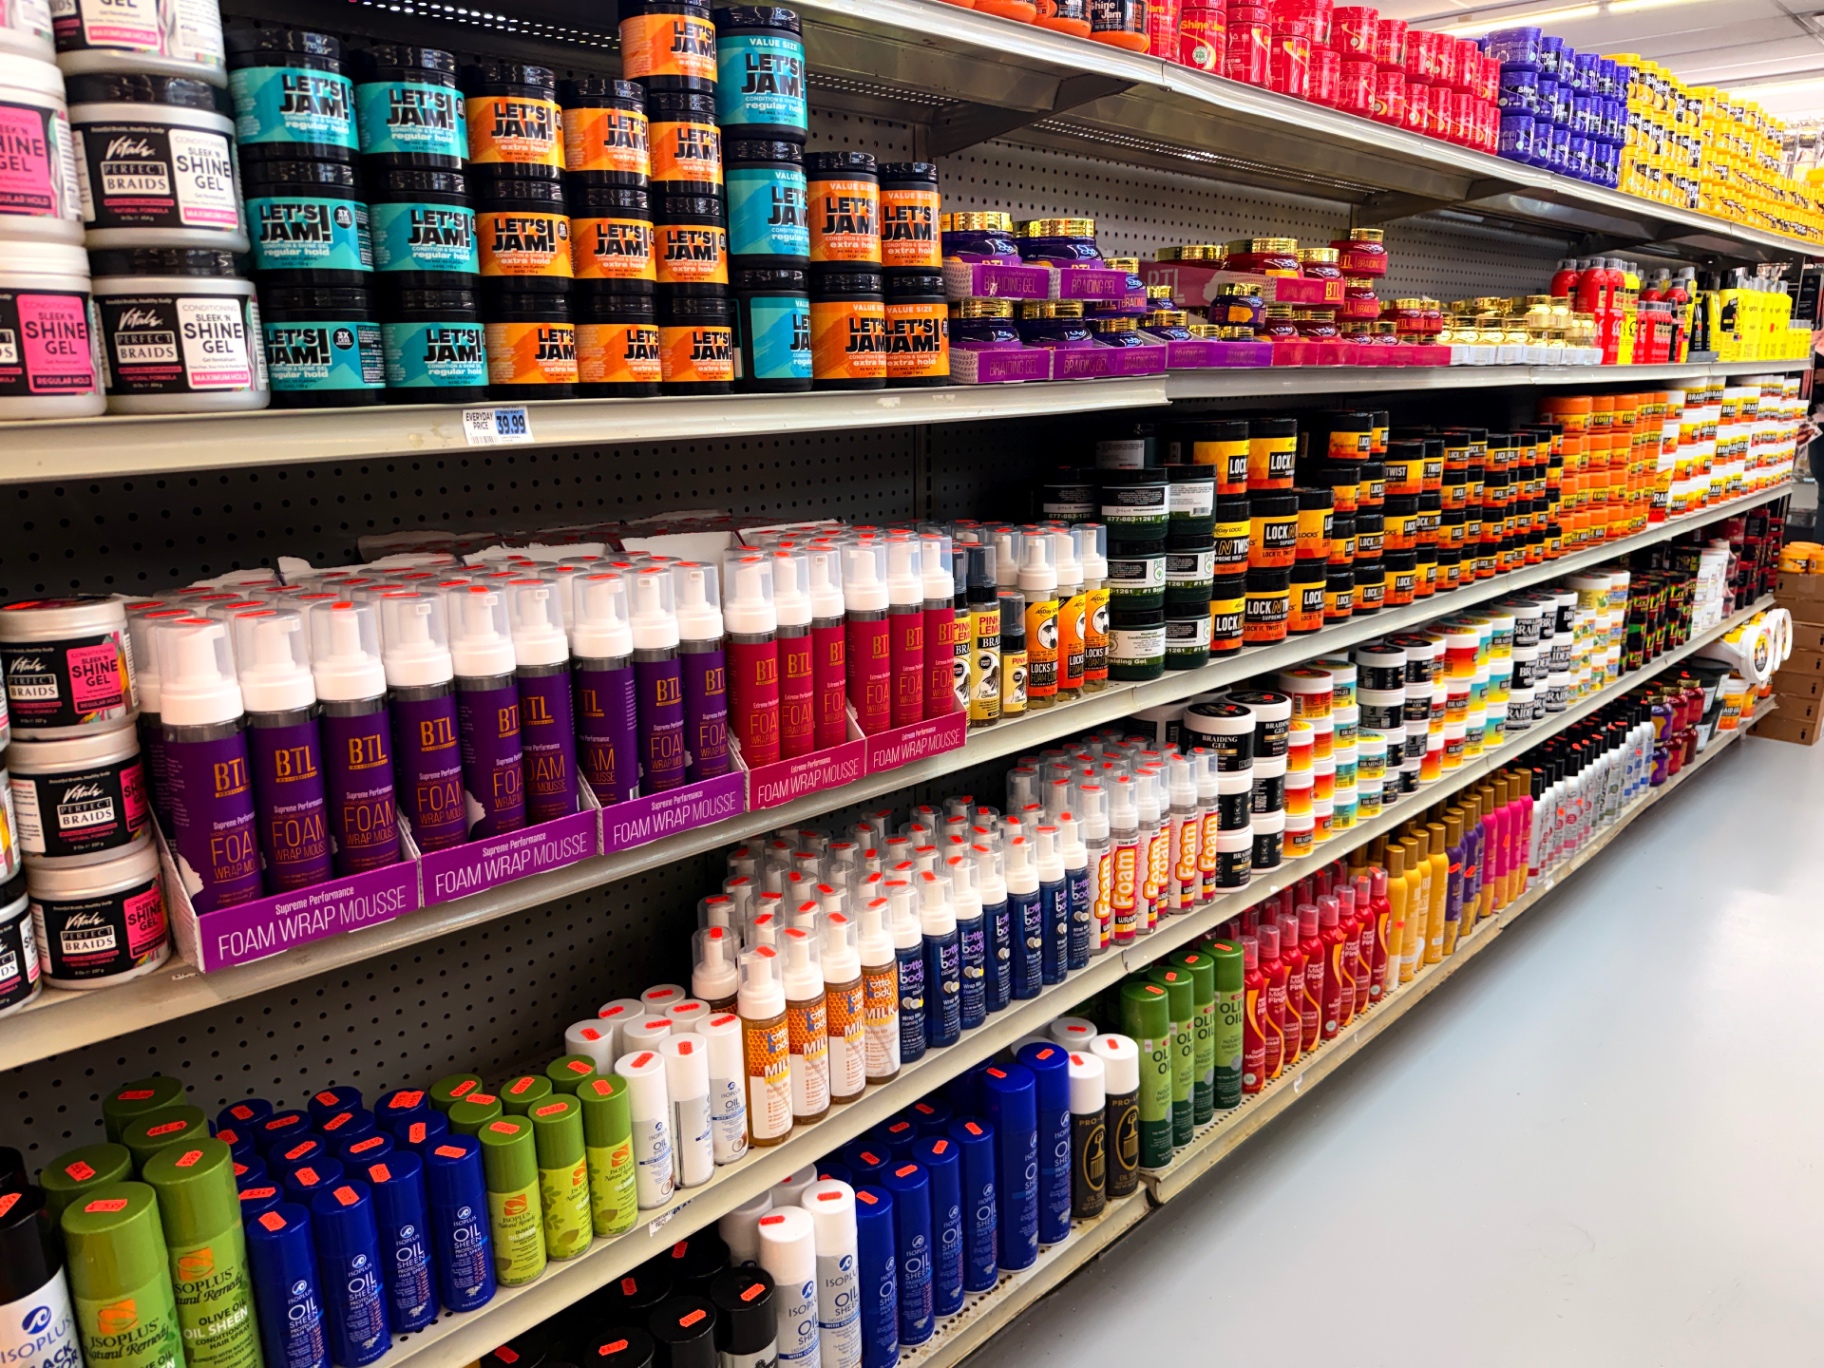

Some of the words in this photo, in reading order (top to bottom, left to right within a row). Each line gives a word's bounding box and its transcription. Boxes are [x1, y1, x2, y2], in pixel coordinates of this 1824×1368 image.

[750, 39, 780, 48] VALUE
[783, 40, 797, 50] SIZE
[746, 53, 798, 72] LET'S
[282, 74, 341, 96] LET'S
[280, 89, 349, 120] JAM!
[389, 89, 445, 108] LET'S
[387, 102, 456, 130] JAM!
[494, 102, 545, 120] LET'S
[491, 118, 554, 140] JAM!
[103, 164, 164, 176] PERFECT
[177, 157, 231, 176] SHINE
[106, 178, 166, 191] BRAIDS
[194, 176, 224, 191] GEL
[830, 182, 857, 190] VALUE
[860, 183, 874, 191] SIZE
[826, 197, 874, 212] LET'S
[260, 205, 319, 222] LET'S
[338, 209, 349, 217] 3X
[411, 210, 464, 228] LET'S
[884, 206, 931, 221] LET'S
[259, 216, 332, 242] JAM!
[494, 218, 545, 234] LET'S
[822, 210, 878, 235] JAM!
[882, 218, 937, 241] JAM!
[409, 220, 470, 247] JAM!
[492, 228, 555, 254] JAM!
[667, 230, 712, 244] LET'S
[264, 248, 301, 256] regular
[304, 248, 330, 256] hold
[664, 241, 717, 261] JAM!
[831, 240, 857, 248] extra
[861, 241, 876, 249] hold
[530, 258, 550, 266] hold
[196, 314, 221, 322] SLEEK
[887, 306, 914, 314] VALUE
[25, 321, 86, 339] SHINE
[184, 322, 242, 339] SHINE
[885, 319, 932, 334] LET'S
[117, 334, 172, 344] PERFECT
[426, 328, 476, 344] LET'S
[538, 329, 574, 343] LET'S
[885, 331, 939, 352] JAM!
[45, 341, 77, 355] GEL
[120, 346, 174, 359] BRAIDS
[203, 341, 233, 353] GEL
[424, 340, 482, 362] JAM!
[193, 374, 230, 384] MAXIMUM
[466, 412, 493, 422] EVERYDAY
[473, 421, 488, 430] PRICE
[1271, 454, 1291, 470] LOCK
[1386, 467, 1406, 477] TWIST
[1266, 525, 1288, 540] LOCK
[1397, 577, 1410, 587] LOCK
[1304, 590, 1321, 603] LOCK
[1247, 601, 1270, 614] LOCK
[1216, 615, 1237, 631] LOCK
[1086, 648, 1102, 658] LOCKS
[71, 660, 118, 678] SHINE
[756, 659, 777, 681] BTL
[788, 652, 810, 674] BTL
[1031, 663, 1050, 673] LOCKS
[8, 677, 54, 685] PERFECT
[86, 675, 110, 687] GEL
[657, 677, 680, 701] BTL
[11, 687, 55, 697] BRAIDS
[420, 717, 455, 747] BTL
[1202, 735, 1238, 743] BRAIDING
[349, 734, 386, 764] BTL
[874, 747, 900, 768] FOAM
[902, 738, 928, 760] WRAP
[929, 729, 960, 752] MOUSSE
[275, 746, 315, 777] BTL
[758, 778, 788, 804] FOAM
[790, 768, 820, 794] WRAP
[823, 759, 858, 784] MOUSSE
[60, 800, 111, 813] PERFECT
[652, 797, 673, 811] Supreme
[673, 790, 703, 805] Performance
[62, 810, 112, 825] BRAIDS
[614, 817, 650, 845] FOAM
[652, 804, 689, 831] WRAP
[692, 792, 735, 821] MOUSSE
[483, 842, 508, 857] Supreme
[510, 832, 546, 850] Performance
[1181, 824, 1196, 879] Foam
[436, 867, 482, 896] FOAM
[485, 851, 530, 880] WRAP
[534, 833, 586, 866] MOUSSE
[1114, 851, 1134, 907] Foam
[275, 900, 308, 915] Supreme
[309, 886, 354, 905] Performance
[219, 925, 276, 960] FOAM
[278, 905, 336, 942] WRAP
[340, 886, 406, 925] MOUSSE
[63, 927, 113, 939] PERFECT
[65, 936, 114, 951] BRAIDS
[900, 959, 923, 973] Lotto
[900, 971, 924, 984] body
[865, 1005, 895, 1019] MILK
[1225, 1014, 1242, 1026] OIL
[454, 1224, 481, 1242] OIL
[454, 1236, 481, 1248] SHEEN
[396, 1243, 423, 1261] OIL
[397, 1255, 425, 1268] SHEEN
[349, 1272, 376, 1292] OIL
[199, 1309, 232, 1326] OLIVE
[233, 1299, 247, 1312] OIL
[288, 1297, 315, 1321] OIL
[184, 1328, 206, 1340] OIL
[208, 1308, 248, 1336] SHEEN
[0, 1317, 71, 1364] ISOPLUS
[90, 1322, 158, 1347] ISOPLUS
